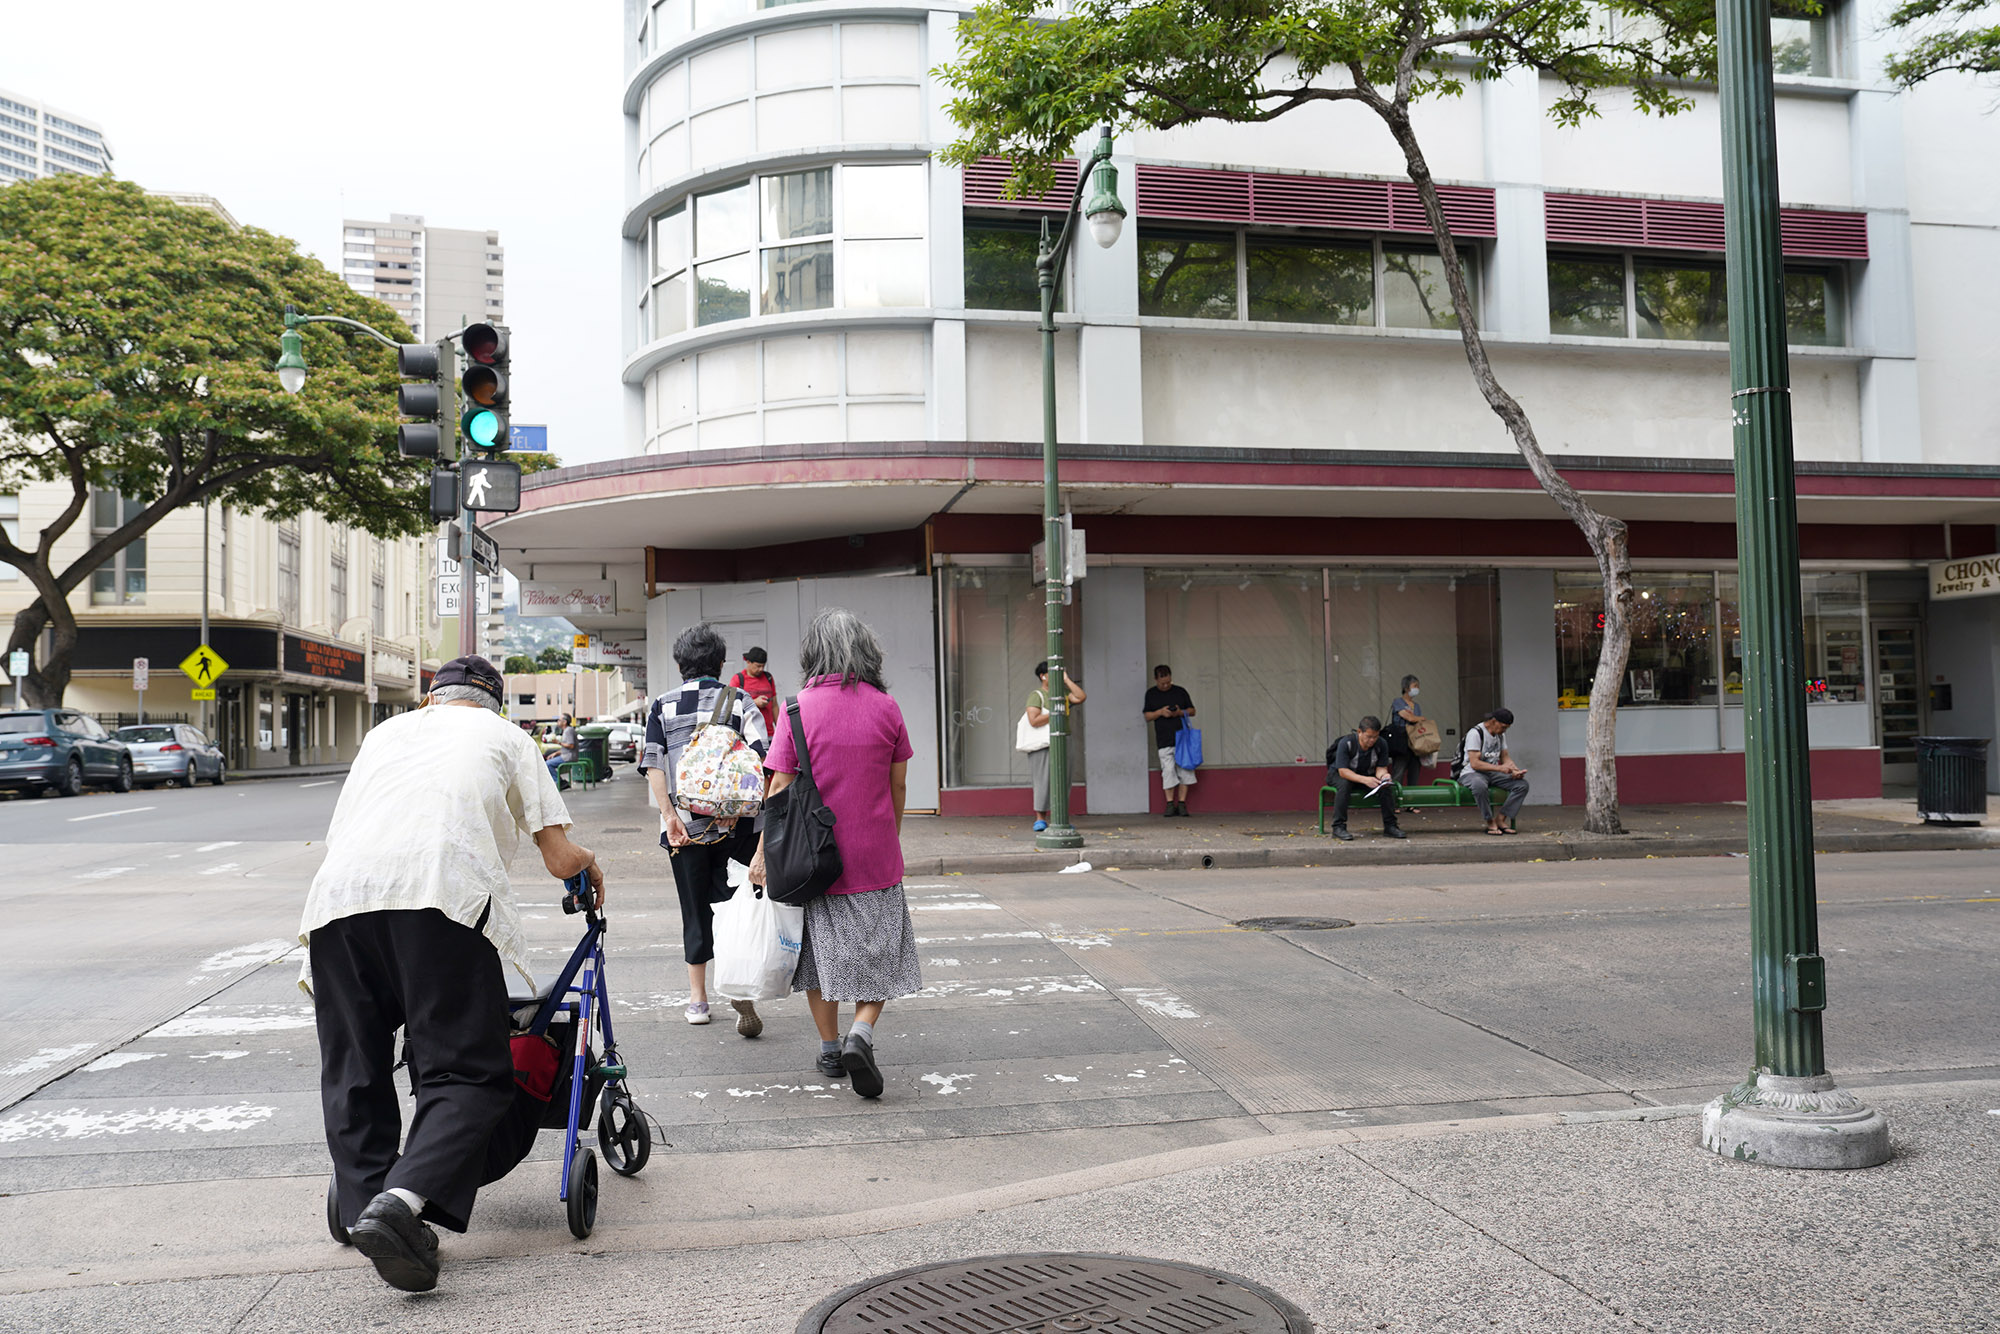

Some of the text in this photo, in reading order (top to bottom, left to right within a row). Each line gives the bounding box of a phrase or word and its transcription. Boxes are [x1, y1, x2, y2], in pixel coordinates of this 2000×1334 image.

[510, 435, 532, 449] TEL
[441, 582, 486, 594] EXCPT
[1936, 581, 1975, 595] Jewelry
[1981, 577, 1990, 588] &
[1805, 680, 1827, 693] ale
